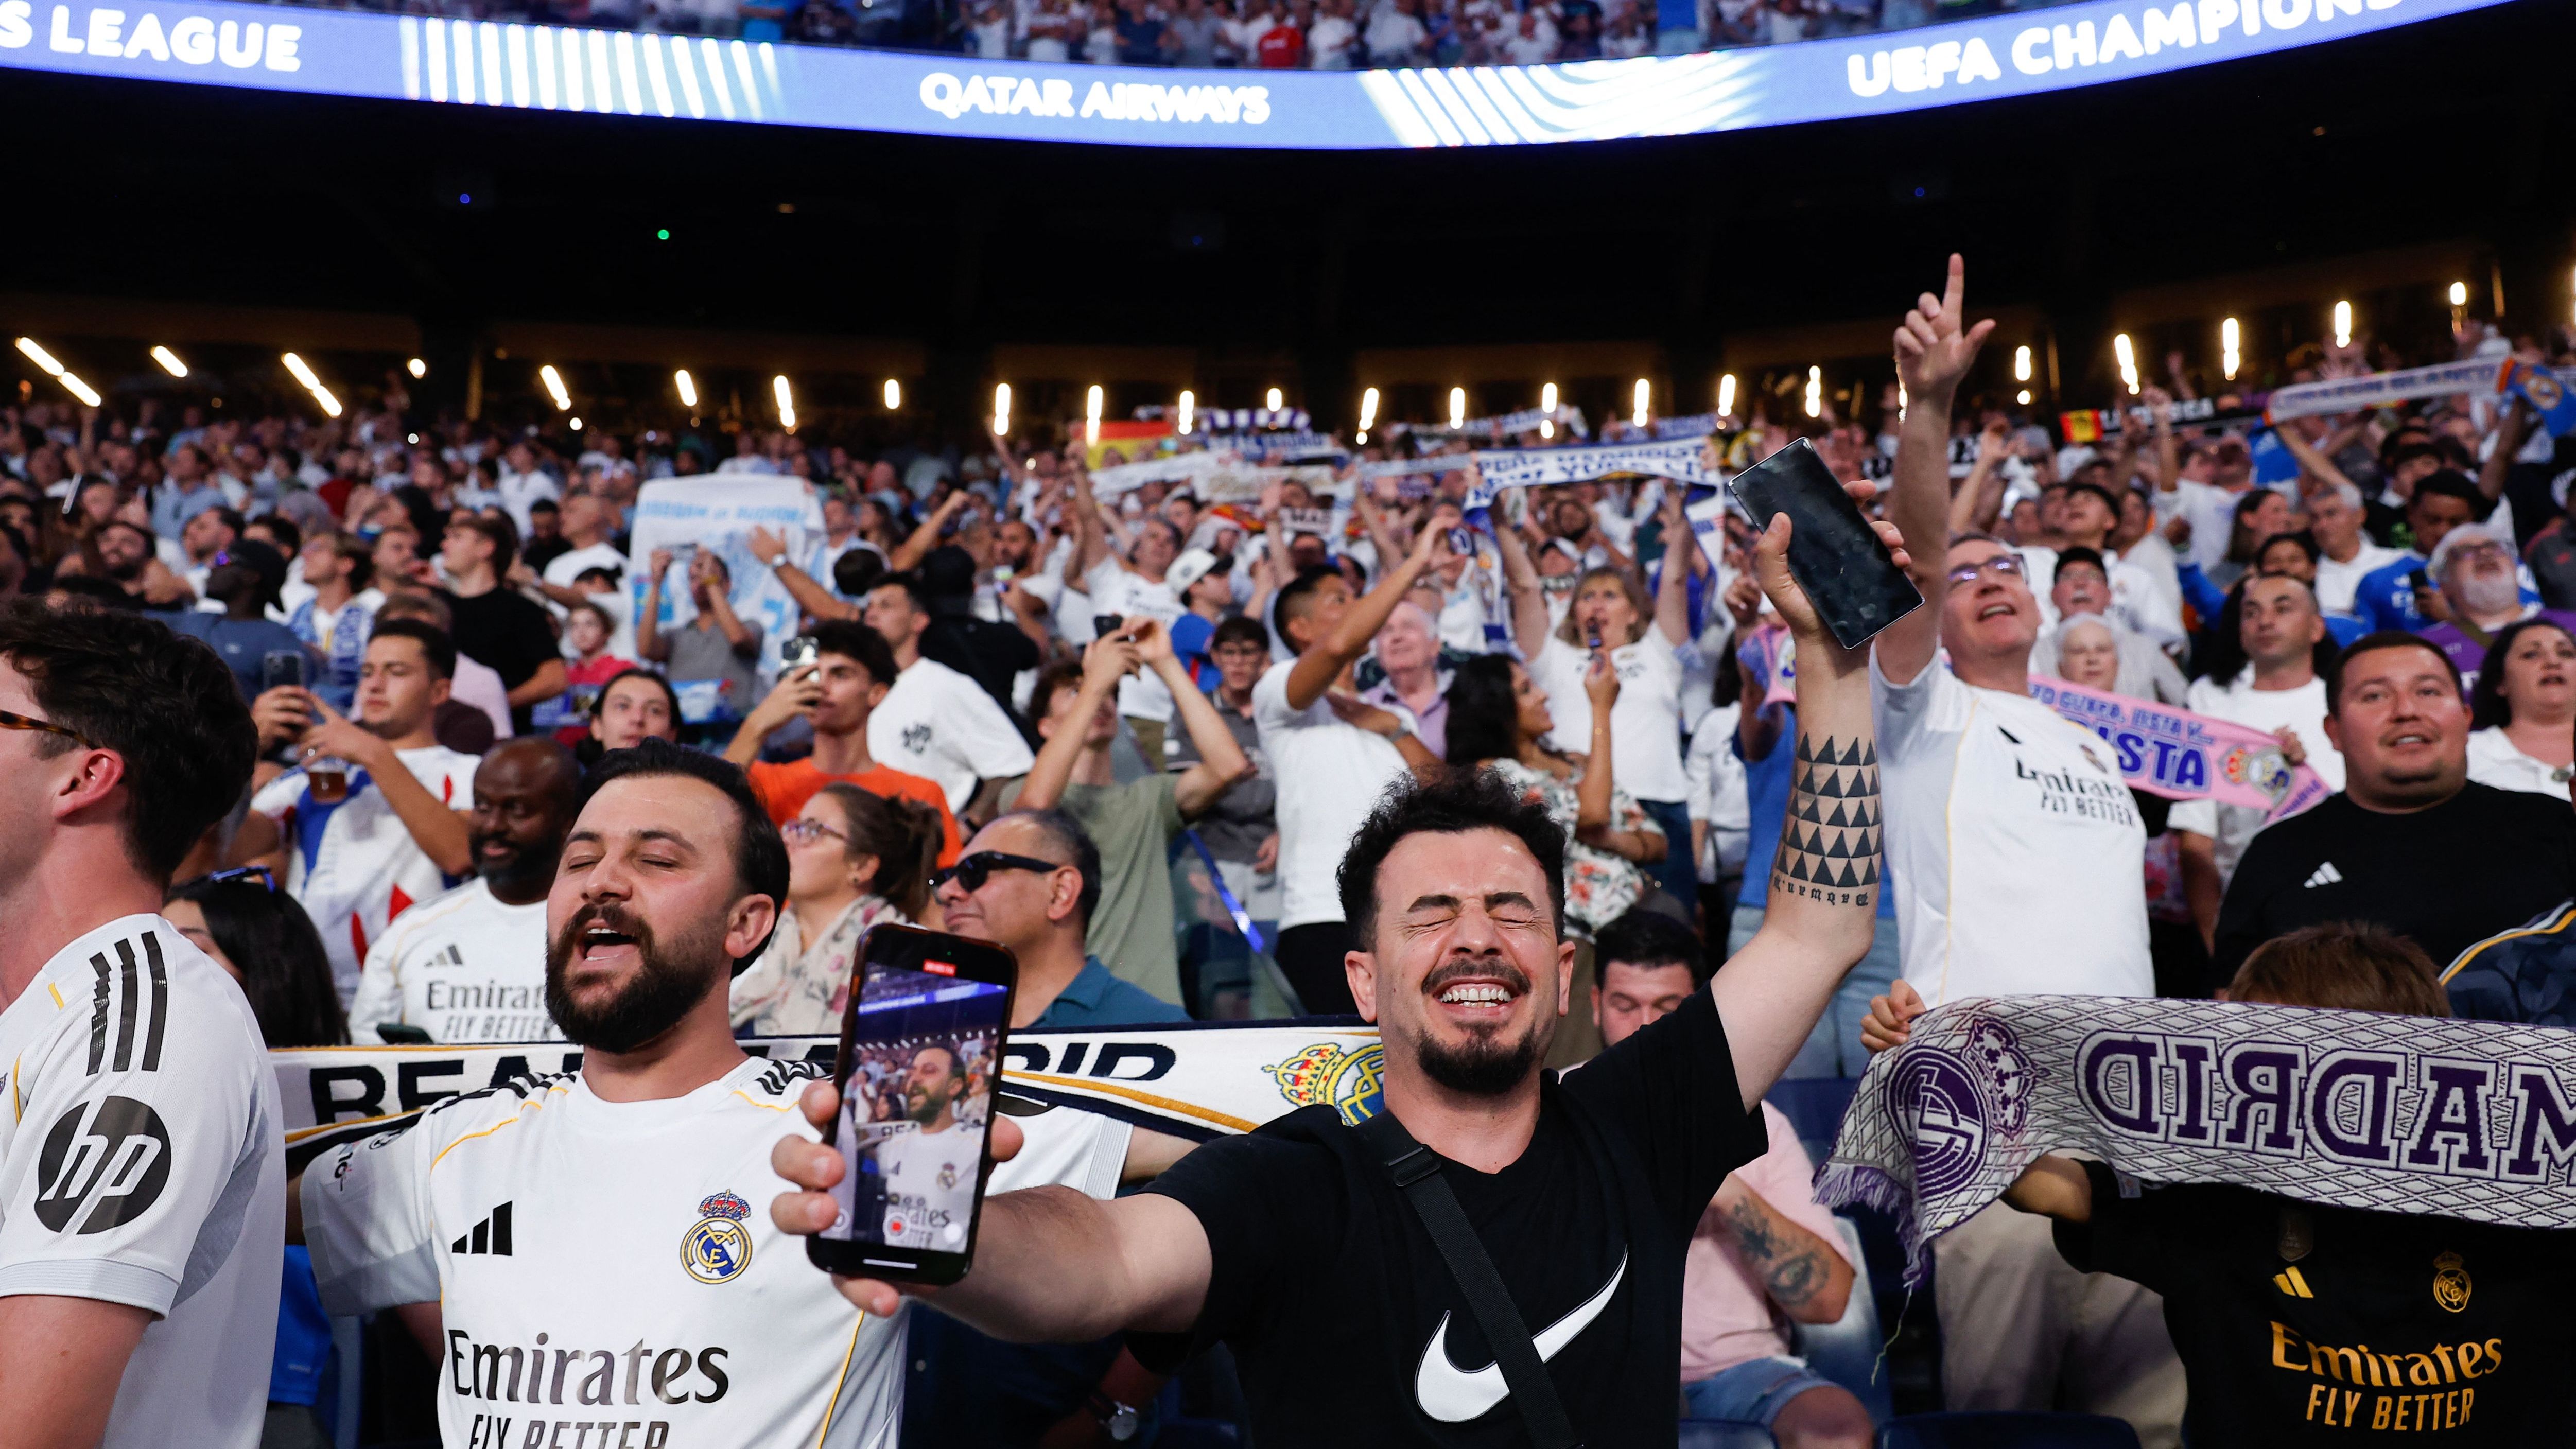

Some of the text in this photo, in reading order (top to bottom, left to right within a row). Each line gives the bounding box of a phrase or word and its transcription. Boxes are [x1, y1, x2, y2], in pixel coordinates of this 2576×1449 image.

[49, 5, 302, 72] LEAGUE
[1847, 0, 2404, 97] UEFA CHAMPIO
[920, 72, 1270, 124] QATAR AIRWAYS
[427, 979, 545, 1010] Emirat
[39, 1097, 163, 1234] hp
[448, 1329, 729, 1405] Emirates
[2270, 1320, 2502, 1387] Emirates
[522, 1420, 670, 1449] BETTER
[2306, 1384, 2474, 1431] FLY BETTER
